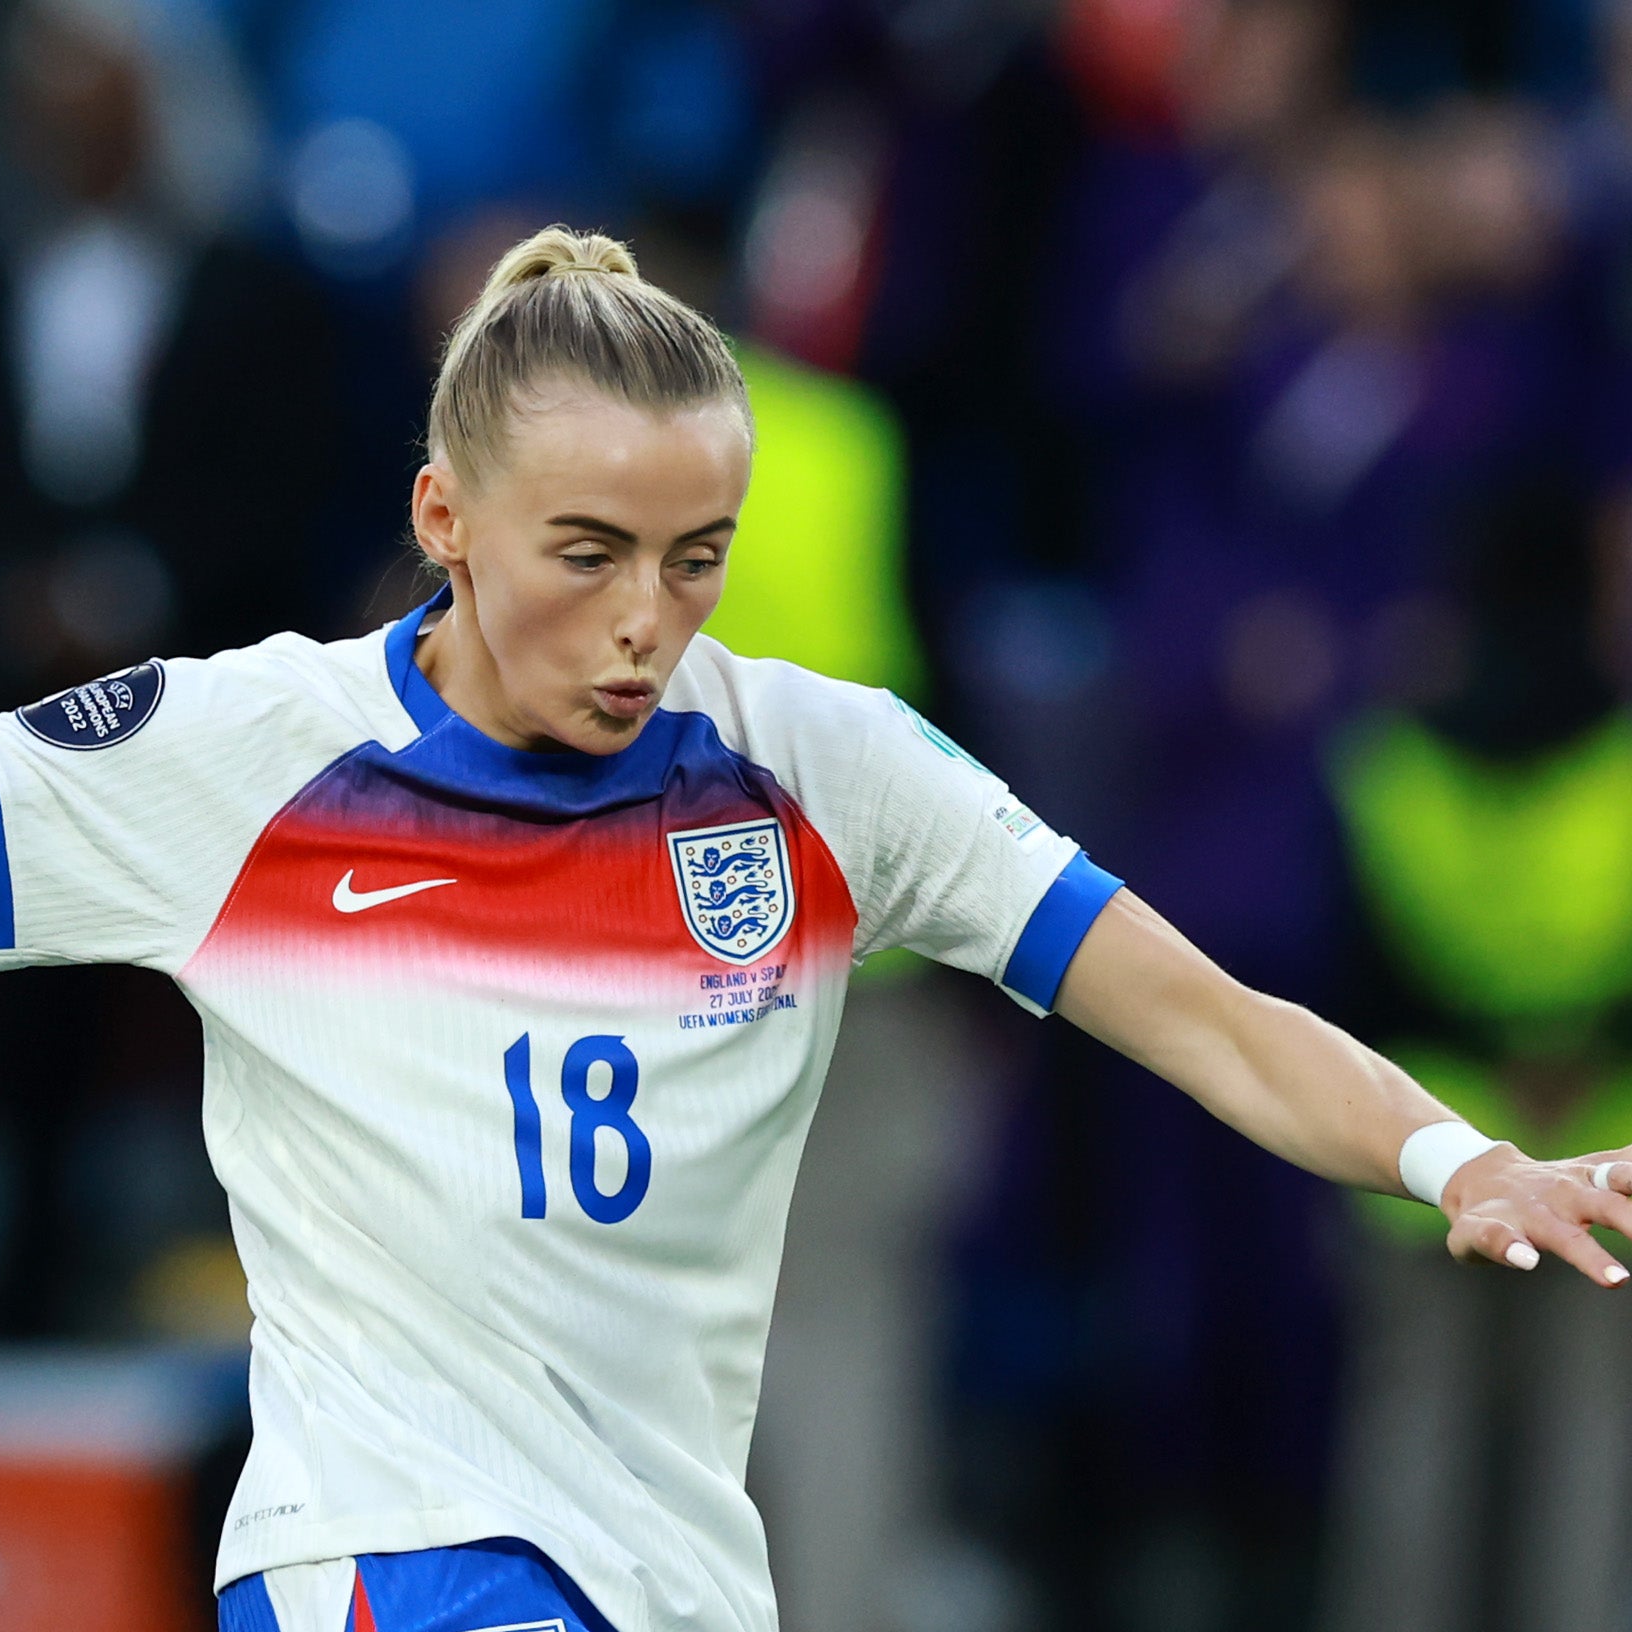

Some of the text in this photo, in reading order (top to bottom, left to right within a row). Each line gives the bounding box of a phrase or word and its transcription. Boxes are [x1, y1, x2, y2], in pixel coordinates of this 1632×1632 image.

[109, 683, 129, 709] UEFA
[60, 698, 87, 731] 2022
[700, 971, 747, 989] ENGLAND
[710, 994, 723, 1009] 27
[728, 989, 753, 1006] JULY
[679, 1014, 706, 1029] UEFA
[707, 1008, 755, 1027] WOMENS
[503, 1030, 652, 1225] 18
